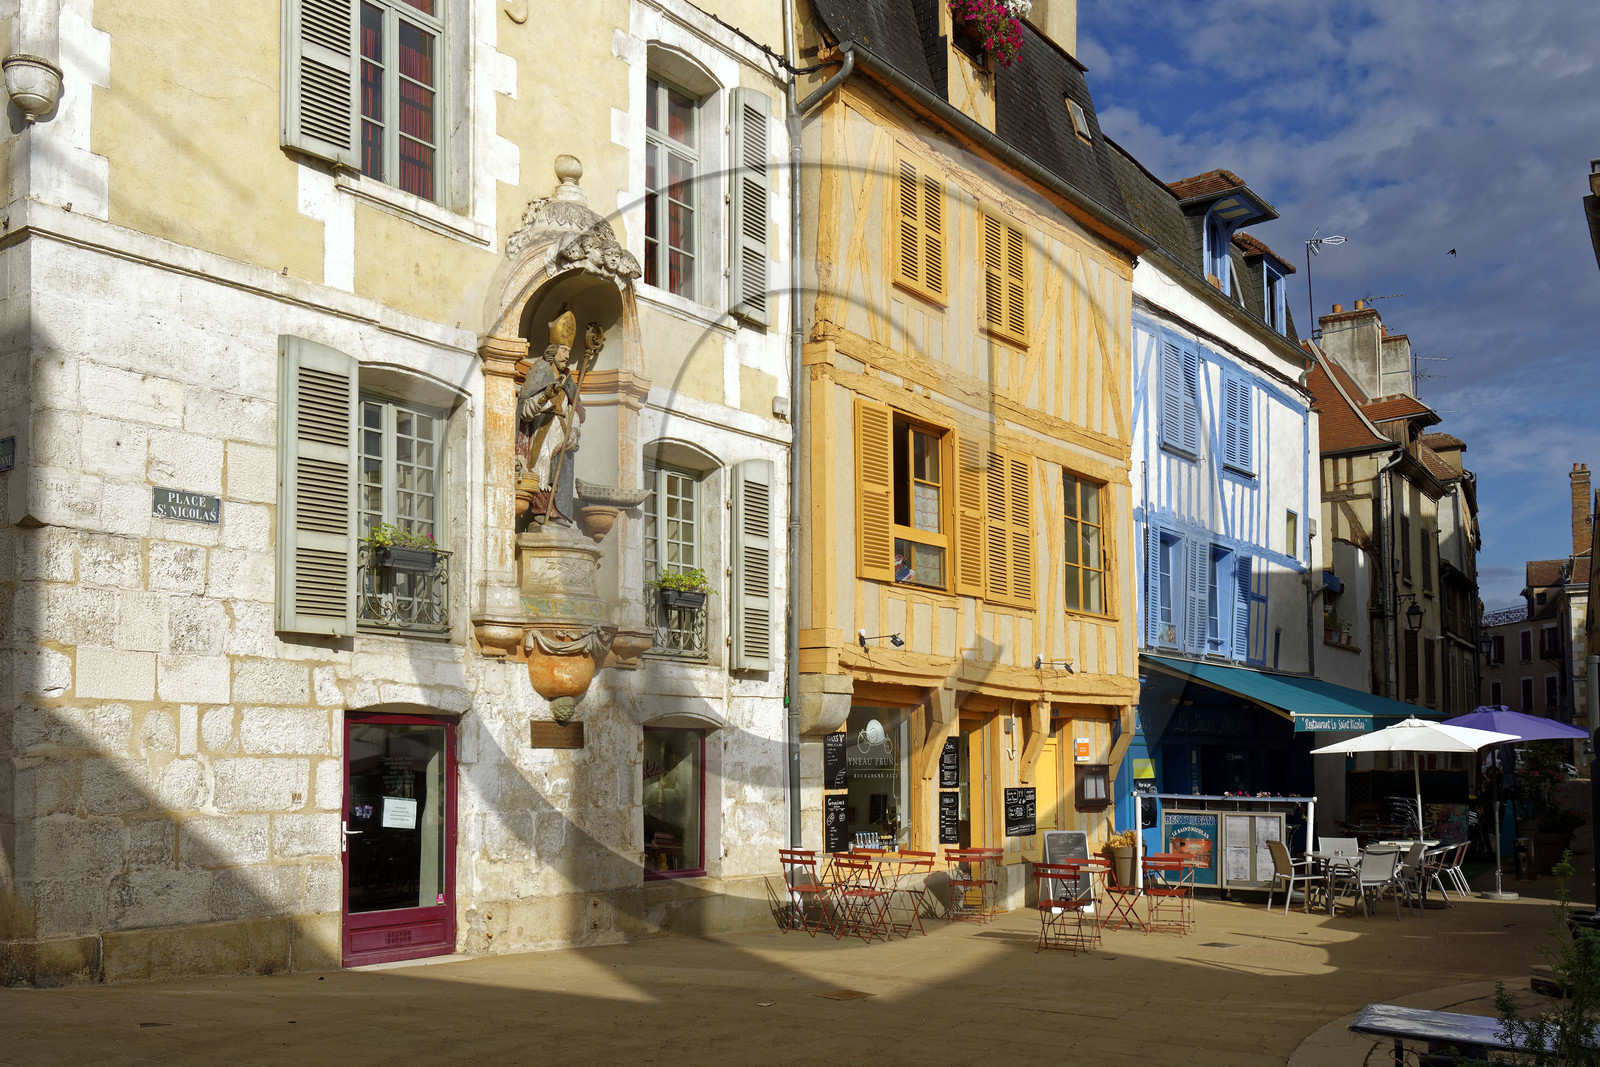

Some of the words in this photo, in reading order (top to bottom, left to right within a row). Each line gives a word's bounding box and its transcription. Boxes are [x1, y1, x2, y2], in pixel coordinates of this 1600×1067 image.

[168, 492, 206, 507] PLACE
[170, 505, 217, 521] NICOLAS
[1338, 718, 1350, 730] Saint
[1165, 814, 1217, 826] RESTAURANT
[1177, 826, 1210, 839] SAINT-NICOLAS
